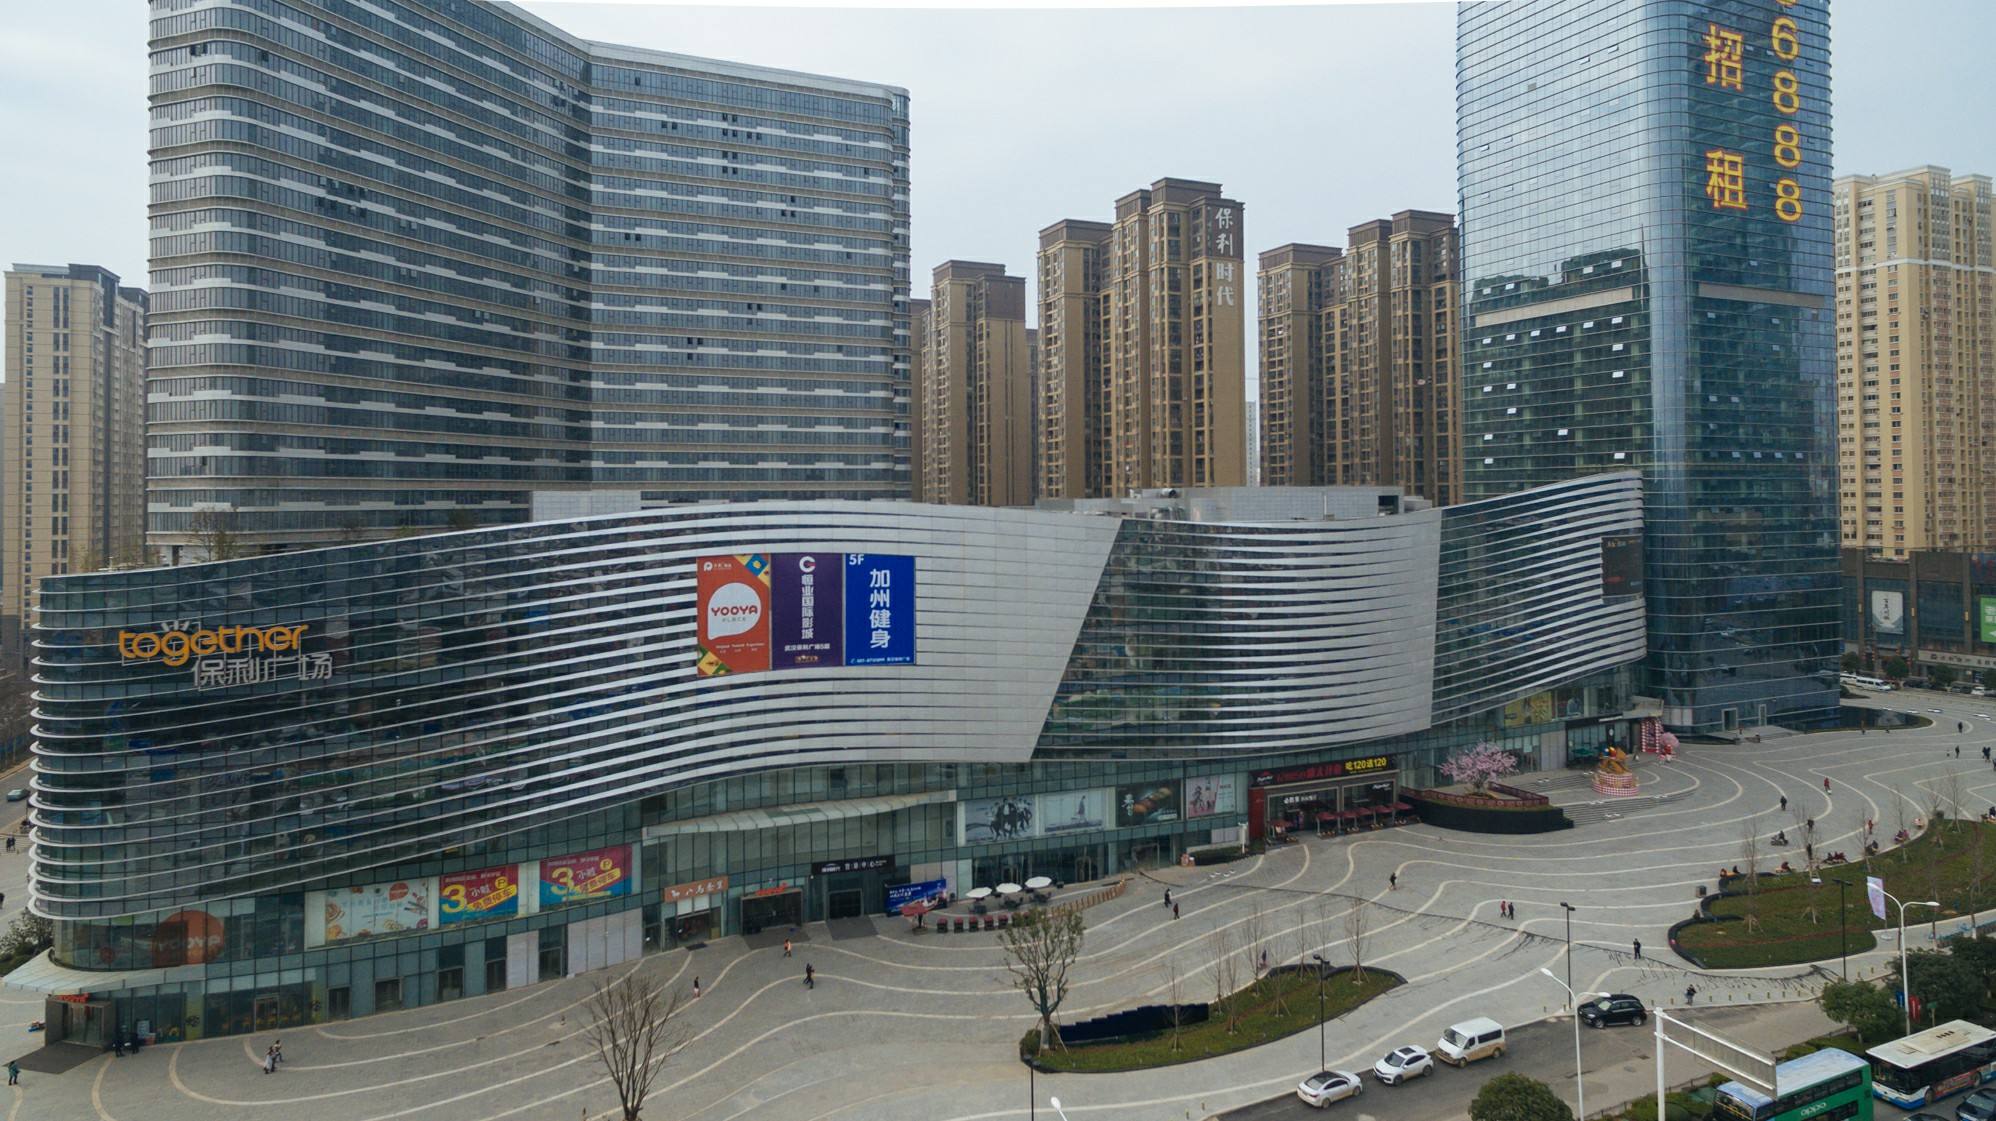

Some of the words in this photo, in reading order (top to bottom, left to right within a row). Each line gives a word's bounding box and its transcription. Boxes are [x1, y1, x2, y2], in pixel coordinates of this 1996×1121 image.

[1702, 22, 1748, 210] 招租
[1771, 0, 1803, 222] 6888
[1215, 207, 1235, 306] 保利时代
[849, 554, 864, 566] 5F
[711, 604, 759, 616] YOOYA
[801, 574, 815, 640] 恒业国际影城
[869, 568, 891, 649] 加州健身
[118, 624, 309, 667] together
[191, 652, 334, 688] 保利广场
[441, 884, 467, 913] 3
[551, 867, 574, 895] 3
